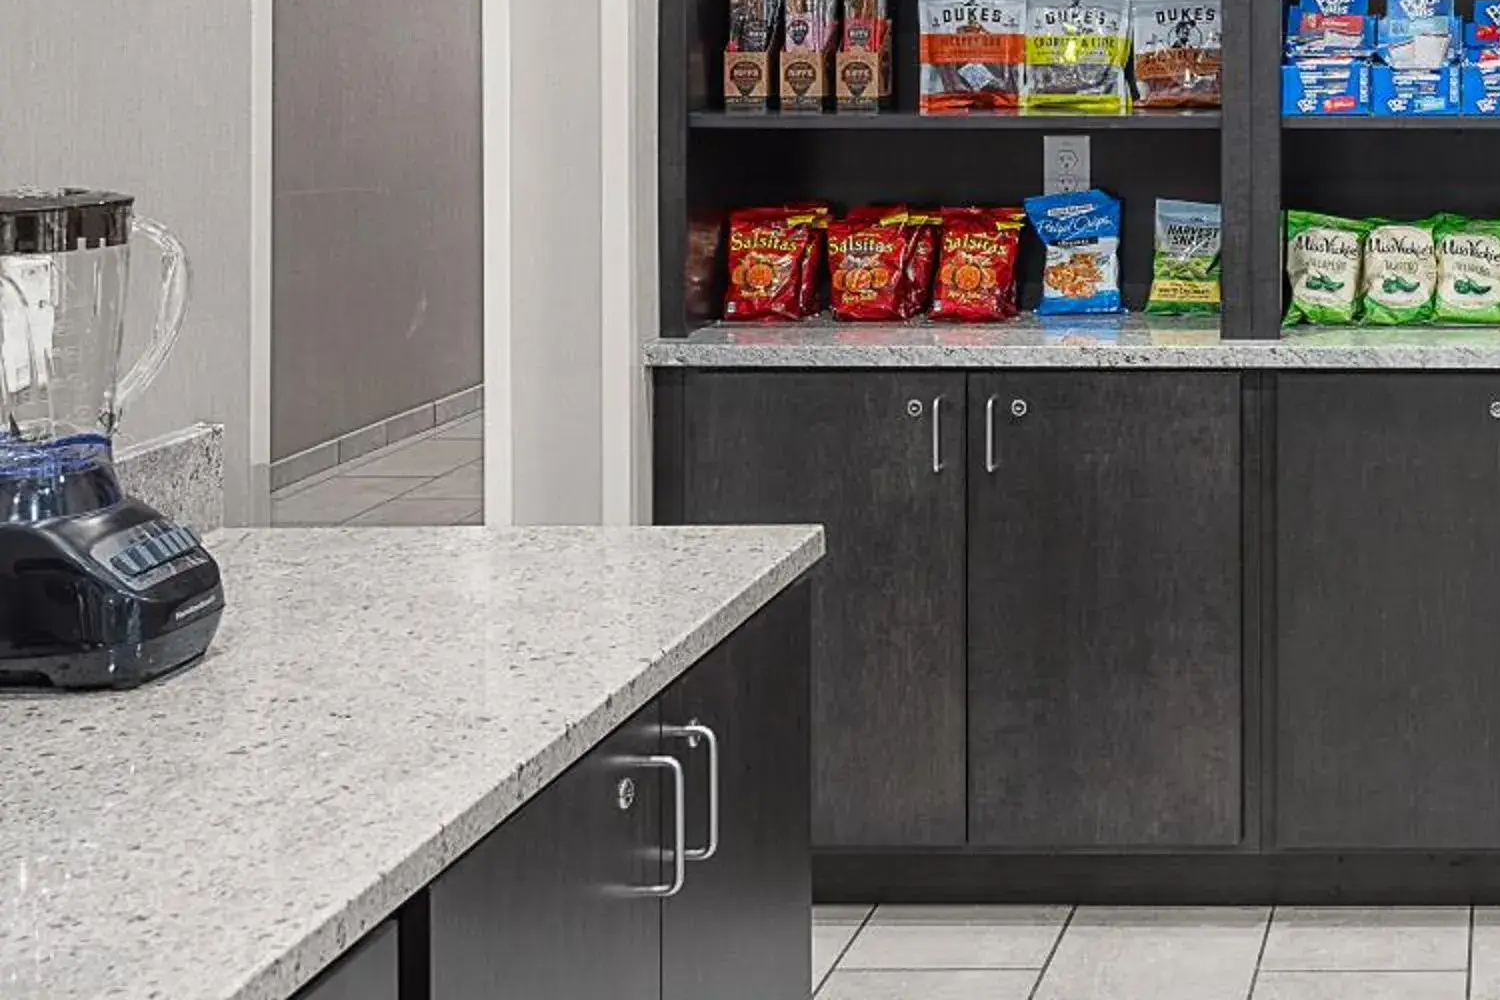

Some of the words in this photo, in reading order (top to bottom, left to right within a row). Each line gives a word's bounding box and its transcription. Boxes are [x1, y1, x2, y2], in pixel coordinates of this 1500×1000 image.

[731, 228, 797, 251] Salsitas
[828, 235, 893, 254] Salsitas
[943, 232, 1008, 255] Salsitas
